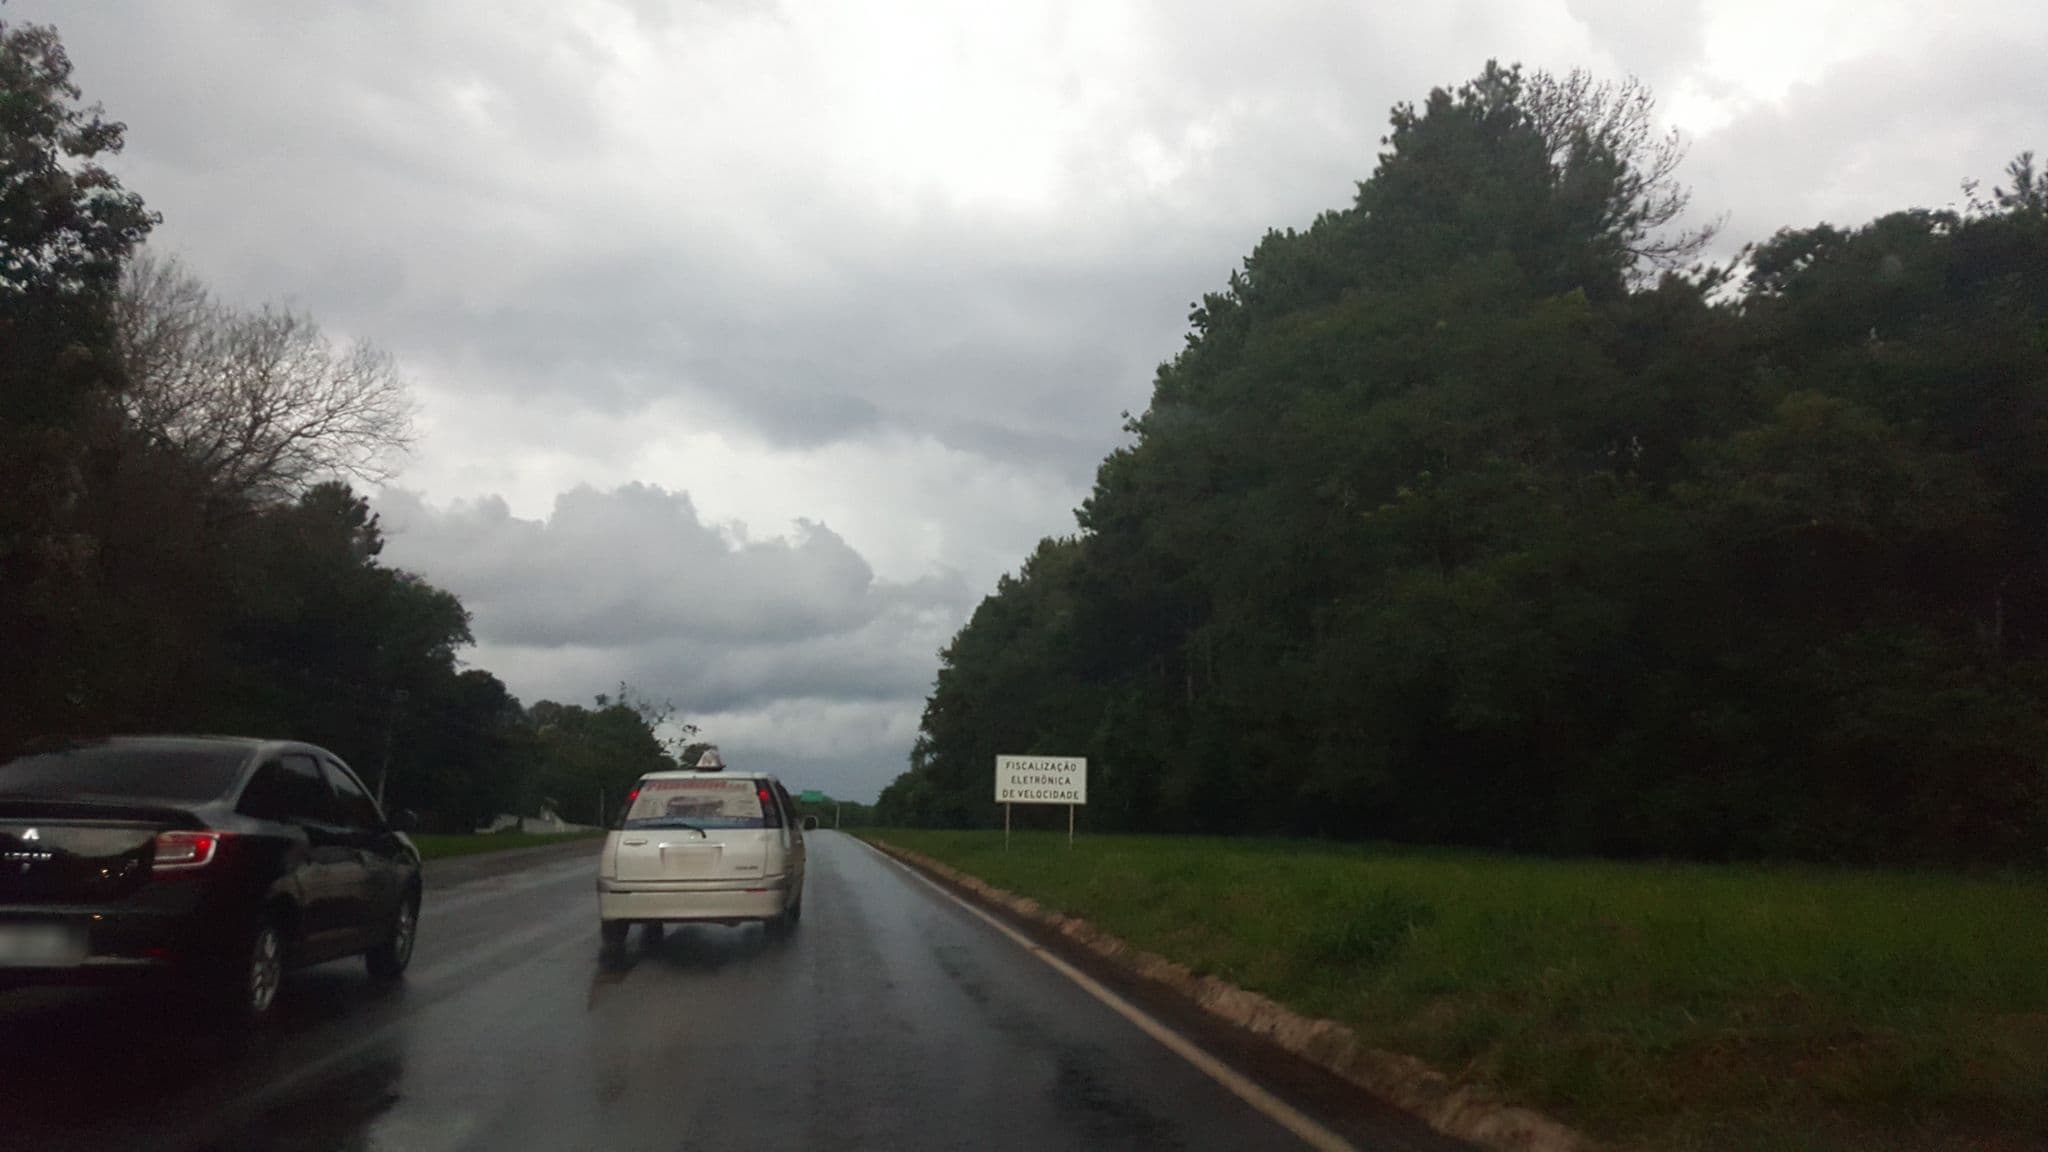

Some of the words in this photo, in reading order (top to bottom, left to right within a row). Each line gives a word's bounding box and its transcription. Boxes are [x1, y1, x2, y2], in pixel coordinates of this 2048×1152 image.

[1006, 761, 1077, 772] FISCALIZAÇÃO
[1010, 775, 1071, 785] ELETRÔNICA
[1002, 789, 1015, 798] DE
[1017, 789, 1079, 800] VELOCIDADE
